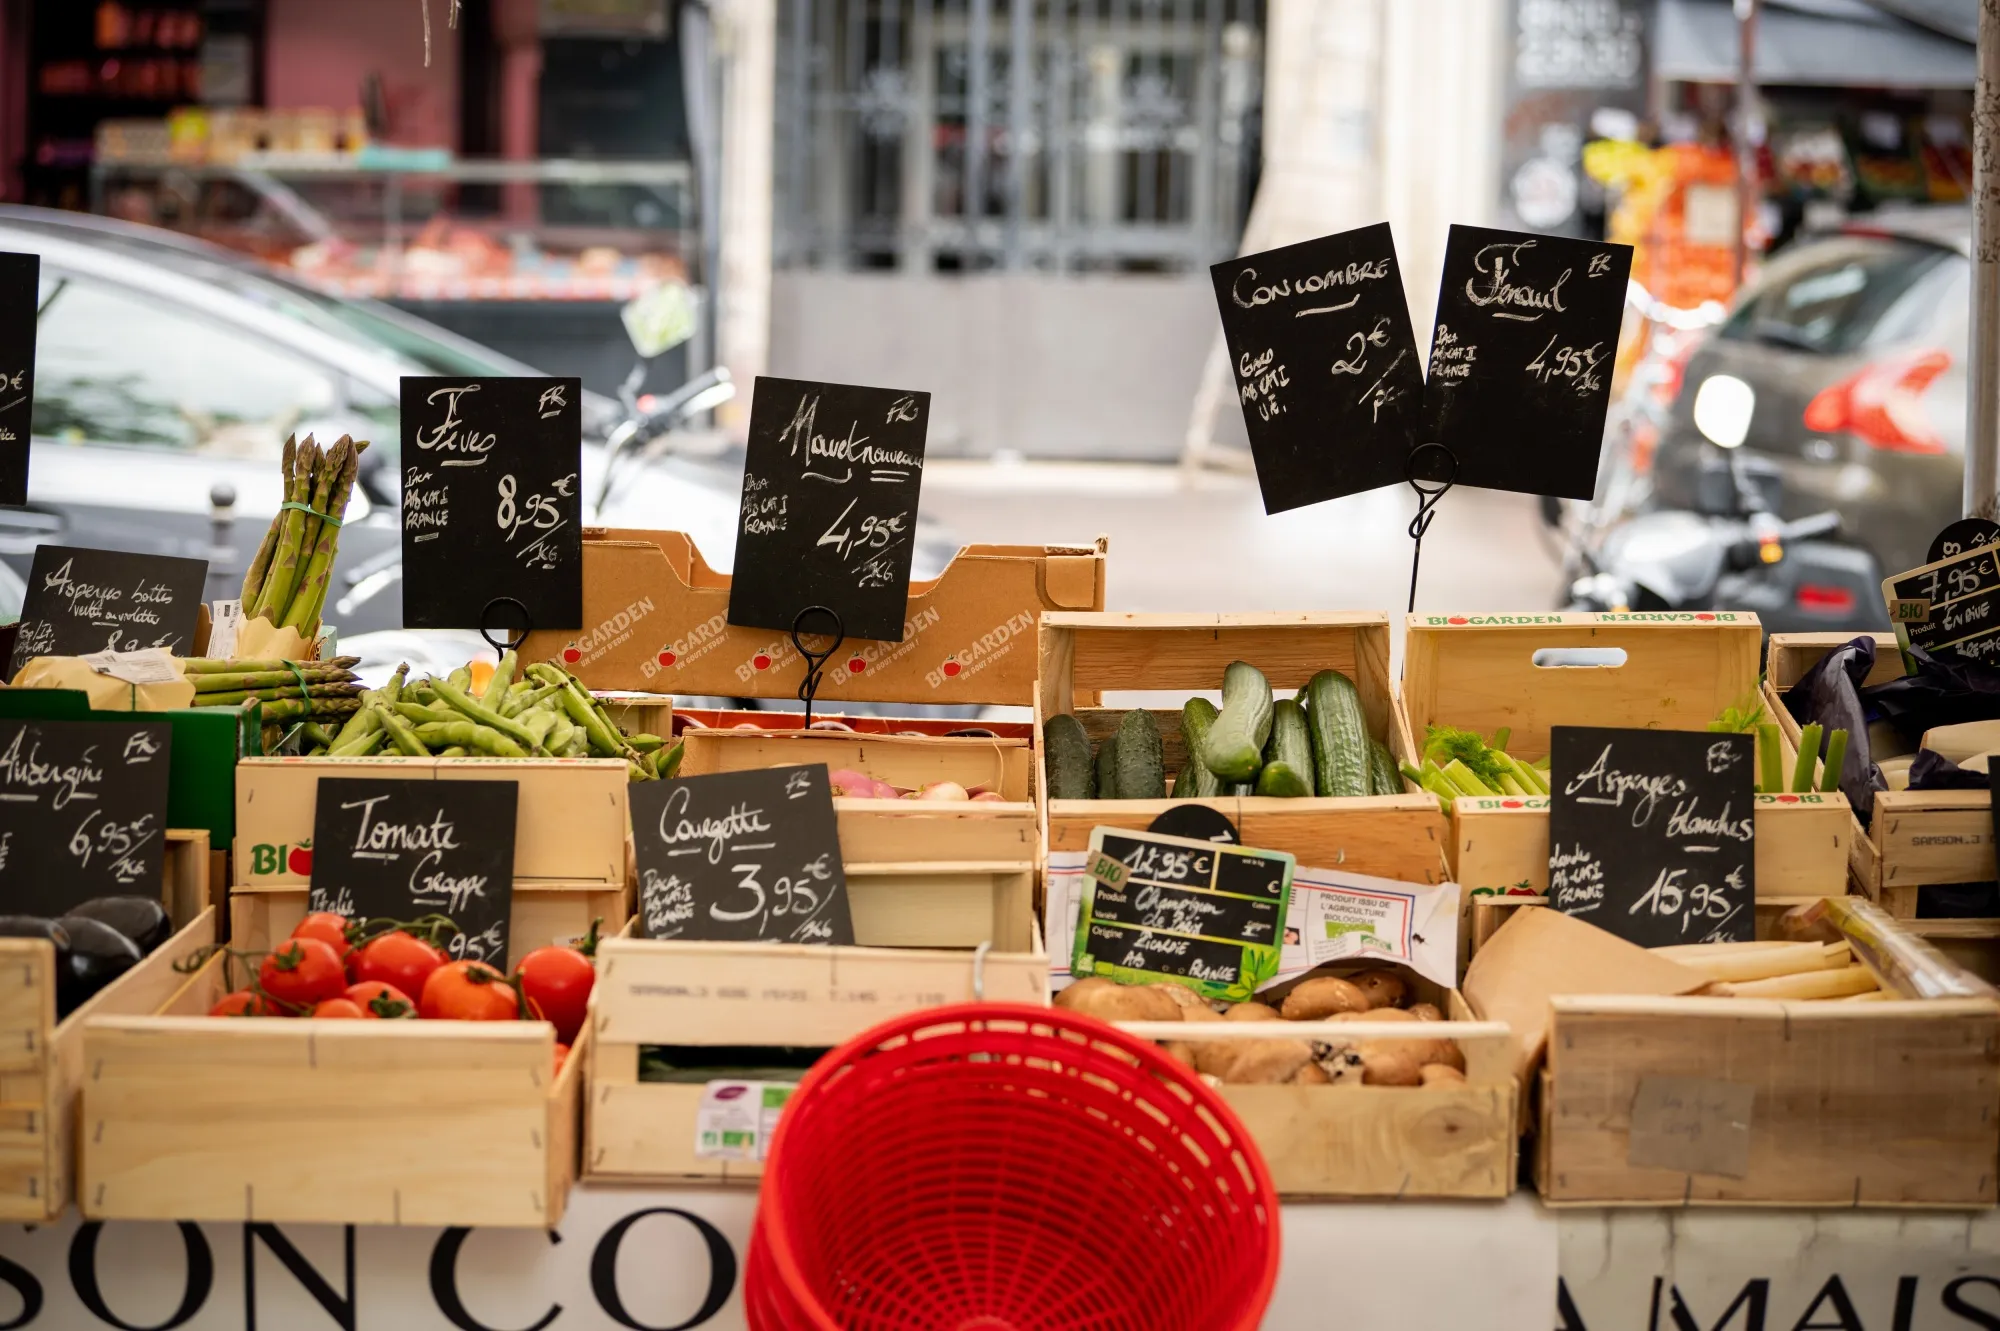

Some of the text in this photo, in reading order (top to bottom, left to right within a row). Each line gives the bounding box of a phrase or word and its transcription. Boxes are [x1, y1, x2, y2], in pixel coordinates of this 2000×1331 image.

[539, 385, 567, 413] FR
[405, 508, 450, 531] FRANCE
[1426, 614, 1563, 626] BIOGARDEN
[1909, 621, 1937, 637] Produit
[924, 609, 1035, 689] BIOGARDEN
[341, 795, 460, 851] Tomate
[1094, 858, 1123, 883] BIO
[1096, 890, 1128, 904] Produit
[1320, 892, 1391, 909] PRODUIT ISSU DE
[1091, 924, 1124, 940] Origine
